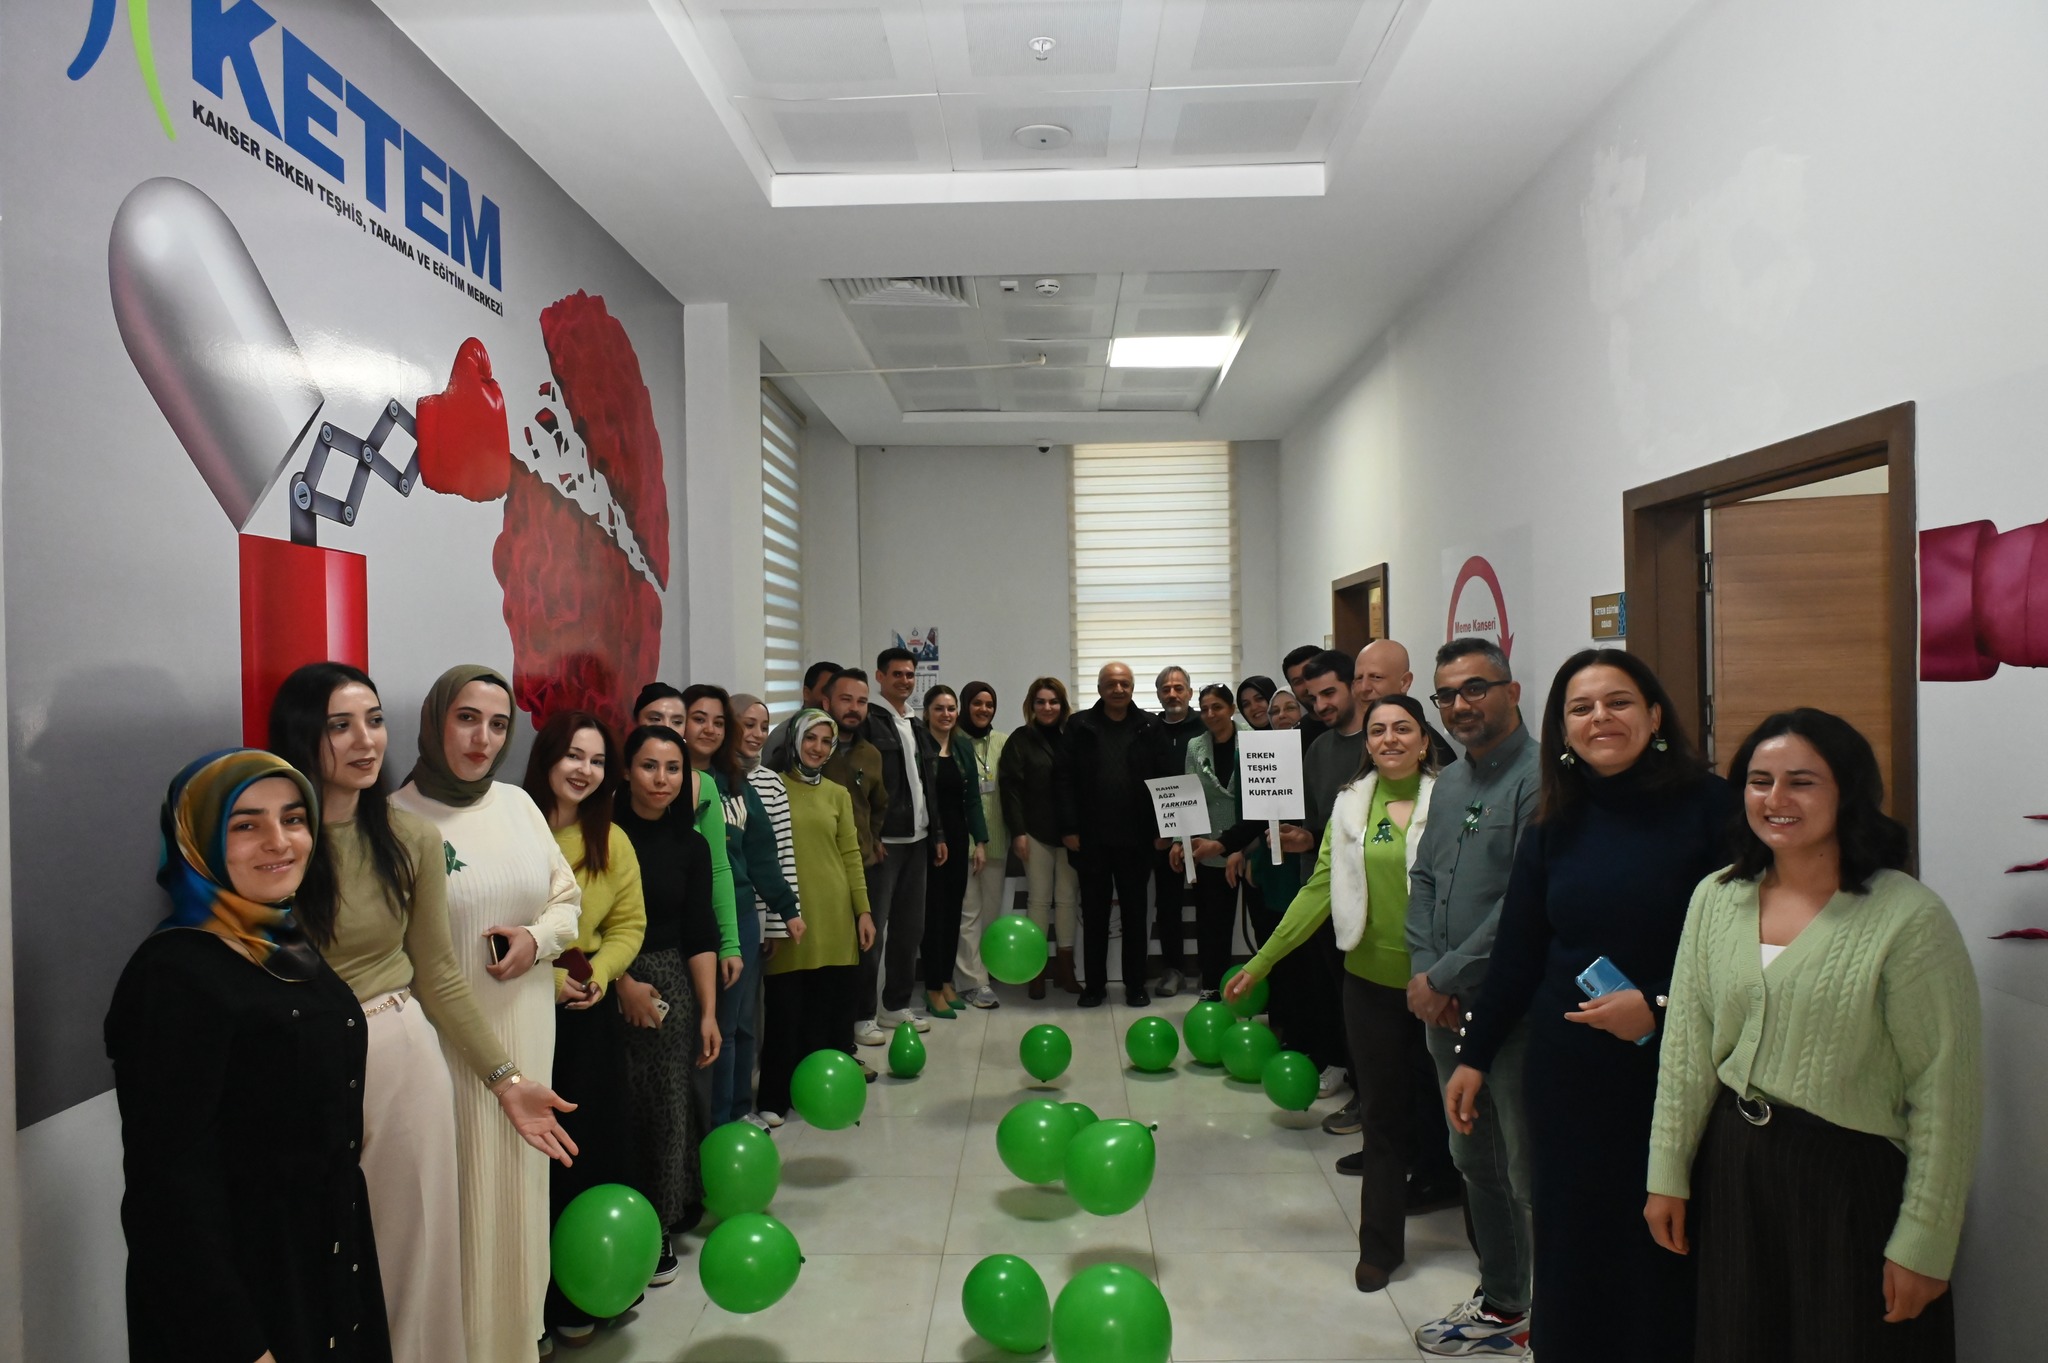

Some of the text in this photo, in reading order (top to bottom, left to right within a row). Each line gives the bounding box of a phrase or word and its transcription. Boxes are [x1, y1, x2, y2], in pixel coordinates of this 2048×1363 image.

[191, 0, 502, 292] KETEM
[192, 99, 504, 318] KANSER ERKEN TEŞHİS, TARAMA VE EĞİTİM MERKEZİ
[1455, 617, 1496, 633] Meme Kanseri
[1247, 763, 1278, 772] TEŞHİS
[1248, 788, 1294, 796] KURTARIR
[1161, 799, 1198, 809] FARKINDA
